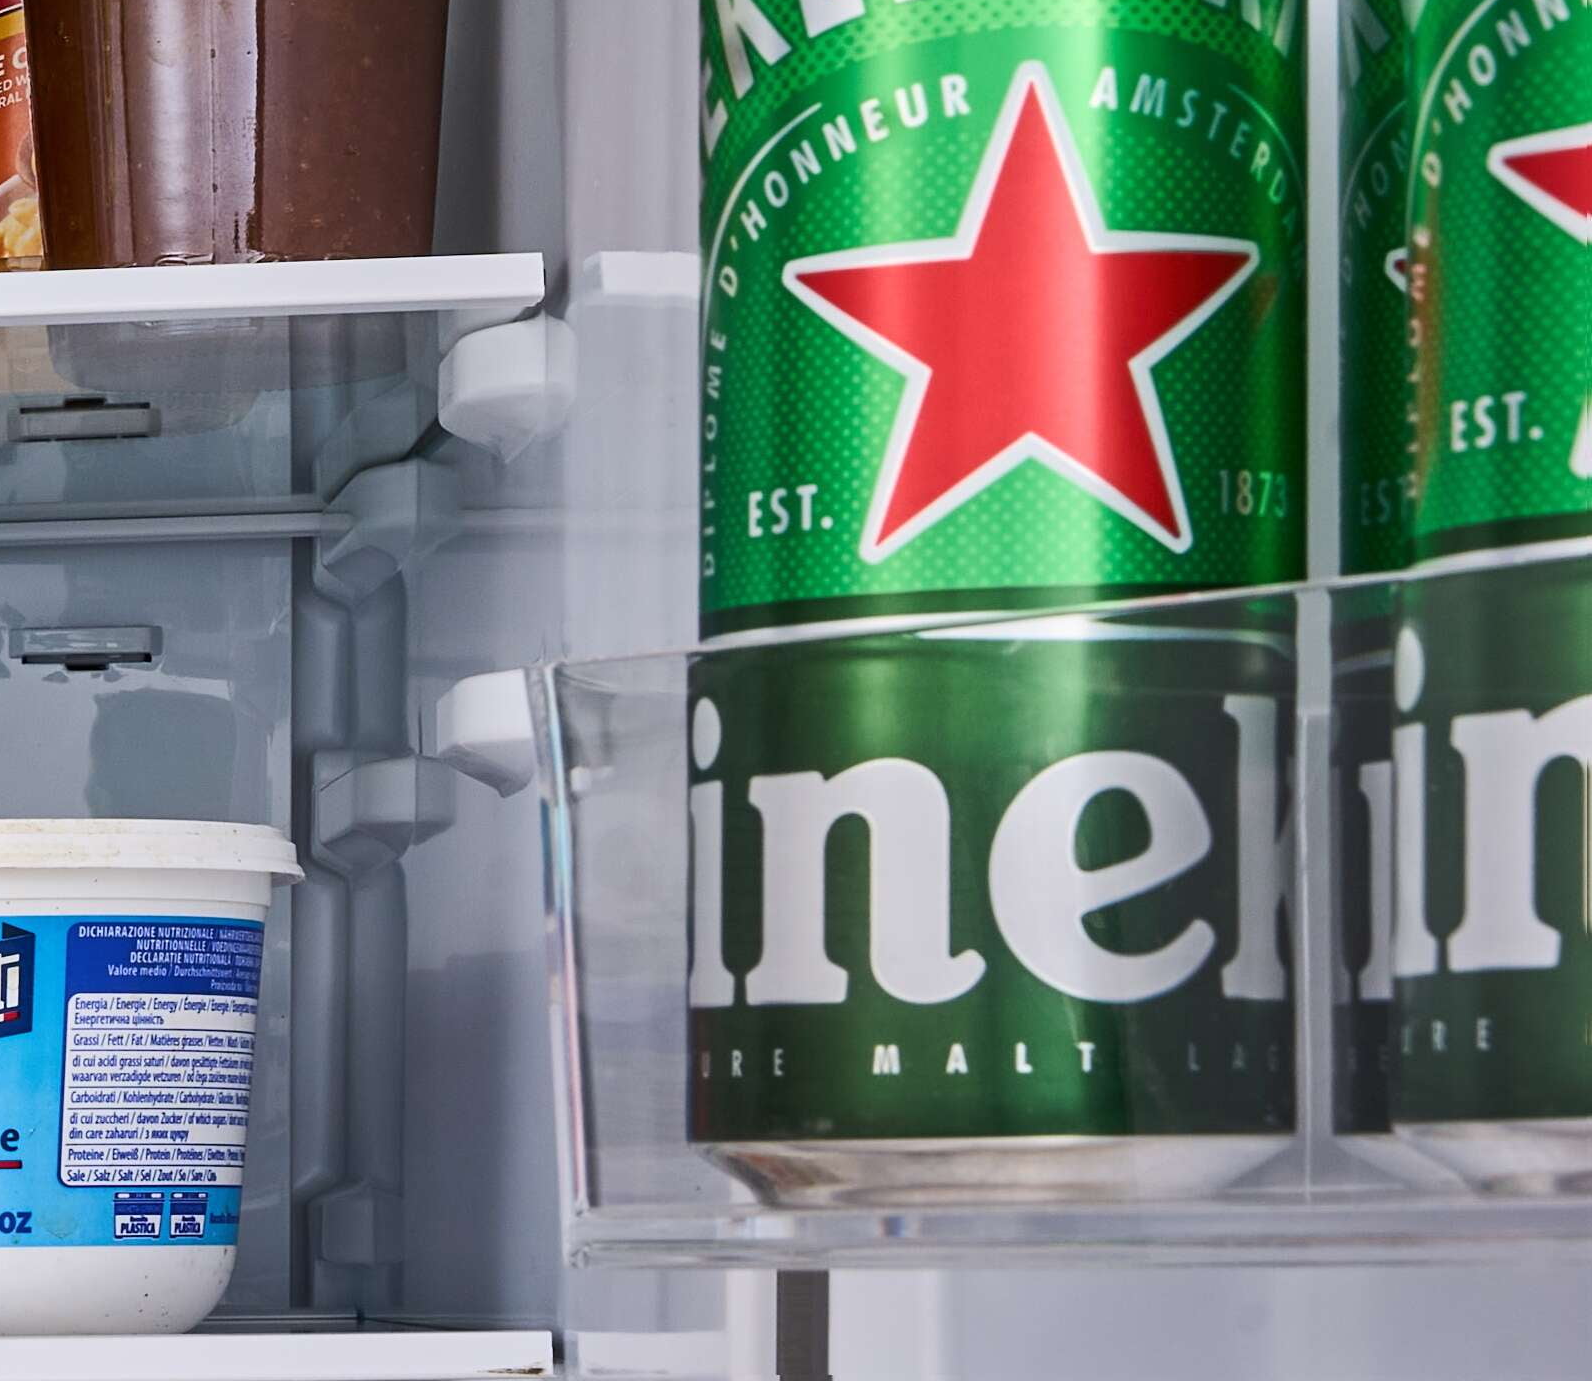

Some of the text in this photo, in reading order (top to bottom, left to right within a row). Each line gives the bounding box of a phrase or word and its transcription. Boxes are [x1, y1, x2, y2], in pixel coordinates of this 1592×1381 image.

[718, 73, 971, 299] D'HONNEUR
[1450, 391, 1544, 453] EST.
[747, 483, 834, 538] EST.
[78, 925, 156, 938] DICHIARAZIONE
[158, 927, 214, 940] NUTRIZIONALE
[136, 938, 207, 952] NUTRITIONNELLE
[108, 964, 139, 977] Valore
[140, 965, 167, 977] medio
[75, 997, 108, 1013] Energia
[116, 998, 146, 1014] Energie
[153, 998, 177, 1014] Energy
[74, 1013, 130, 1027] Енергетична
[73, 1034, 100, 1046] Grassi
[107, 1034, 124, 1046] Fett
[131, 1034, 143, 1046] Fat
[150, 1034, 180, 1047] Matières
[72, 1055, 81, 1067] di
[83, 1056, 96, 1068] cui
[97, 1055, 117, 1068] acidi
[119, 1056, 143, 1071] grassi
[144, 1056, 165, 1068] saturi
[872, 1041, 1096, 1077] MALT
[72, 1073, 108, 1083] waarvan
[110, 1070, 151, 1085] verzadigde
[70, 1090, 116, 1104] Carboidrati
[122, 1091, 174, 1107] Kohlenhydrate
[69, 1112, 78, 1125] di
[80, 1113, 93, 1125] cui
[95, 1112, 130, 1125] zuccheri
[136, 1112, 160, 1125] davon
[160, 1111, 183, 1125] Zucker
[69, 1128, 83, 1140] din
[85, 1130, 104, 1140] care
[105, 1128, 139, 1140] zaharuri
[68, 1148, 105, 1162] Proteine
[112, 1147, 139, 1161] Eiweiß
[145, 1148, 170, 1161] Protein
[67, 1169, 86, 1182] Sale
[93, 1169, 111, 1182] Salz
[118, 1169, 133, 1182] Salt
[140, 1169, 152, 1182] Sel
[120, 1222, 156, 1235] PLASTICA
